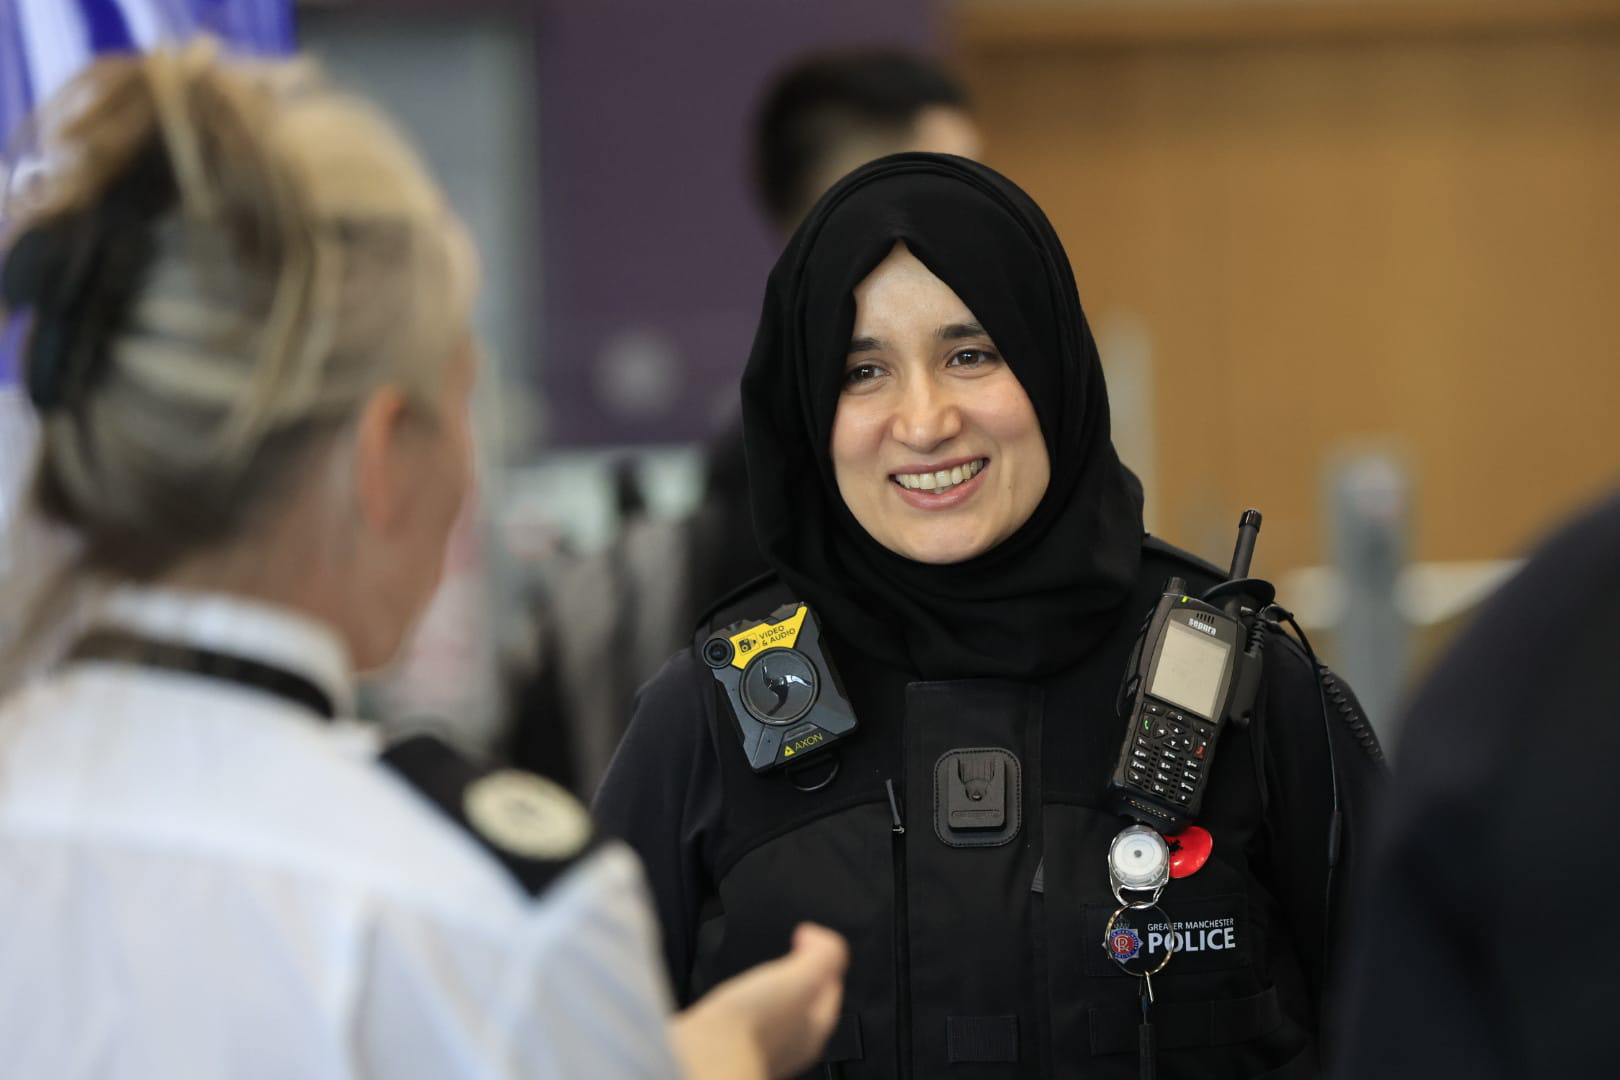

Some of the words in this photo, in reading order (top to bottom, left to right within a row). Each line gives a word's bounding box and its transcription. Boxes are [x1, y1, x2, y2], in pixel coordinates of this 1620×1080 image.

[759, 625, 785, 640] VIDEO
[770, 627, 796, 645] AUDIO
[795, 733, 823, 751] AXON
[1147, 922, 1183, 931] GREAER
[1185, 918, 1234, 930] MANCHESTER
[1148, 927, 1236, 953] POLICE
